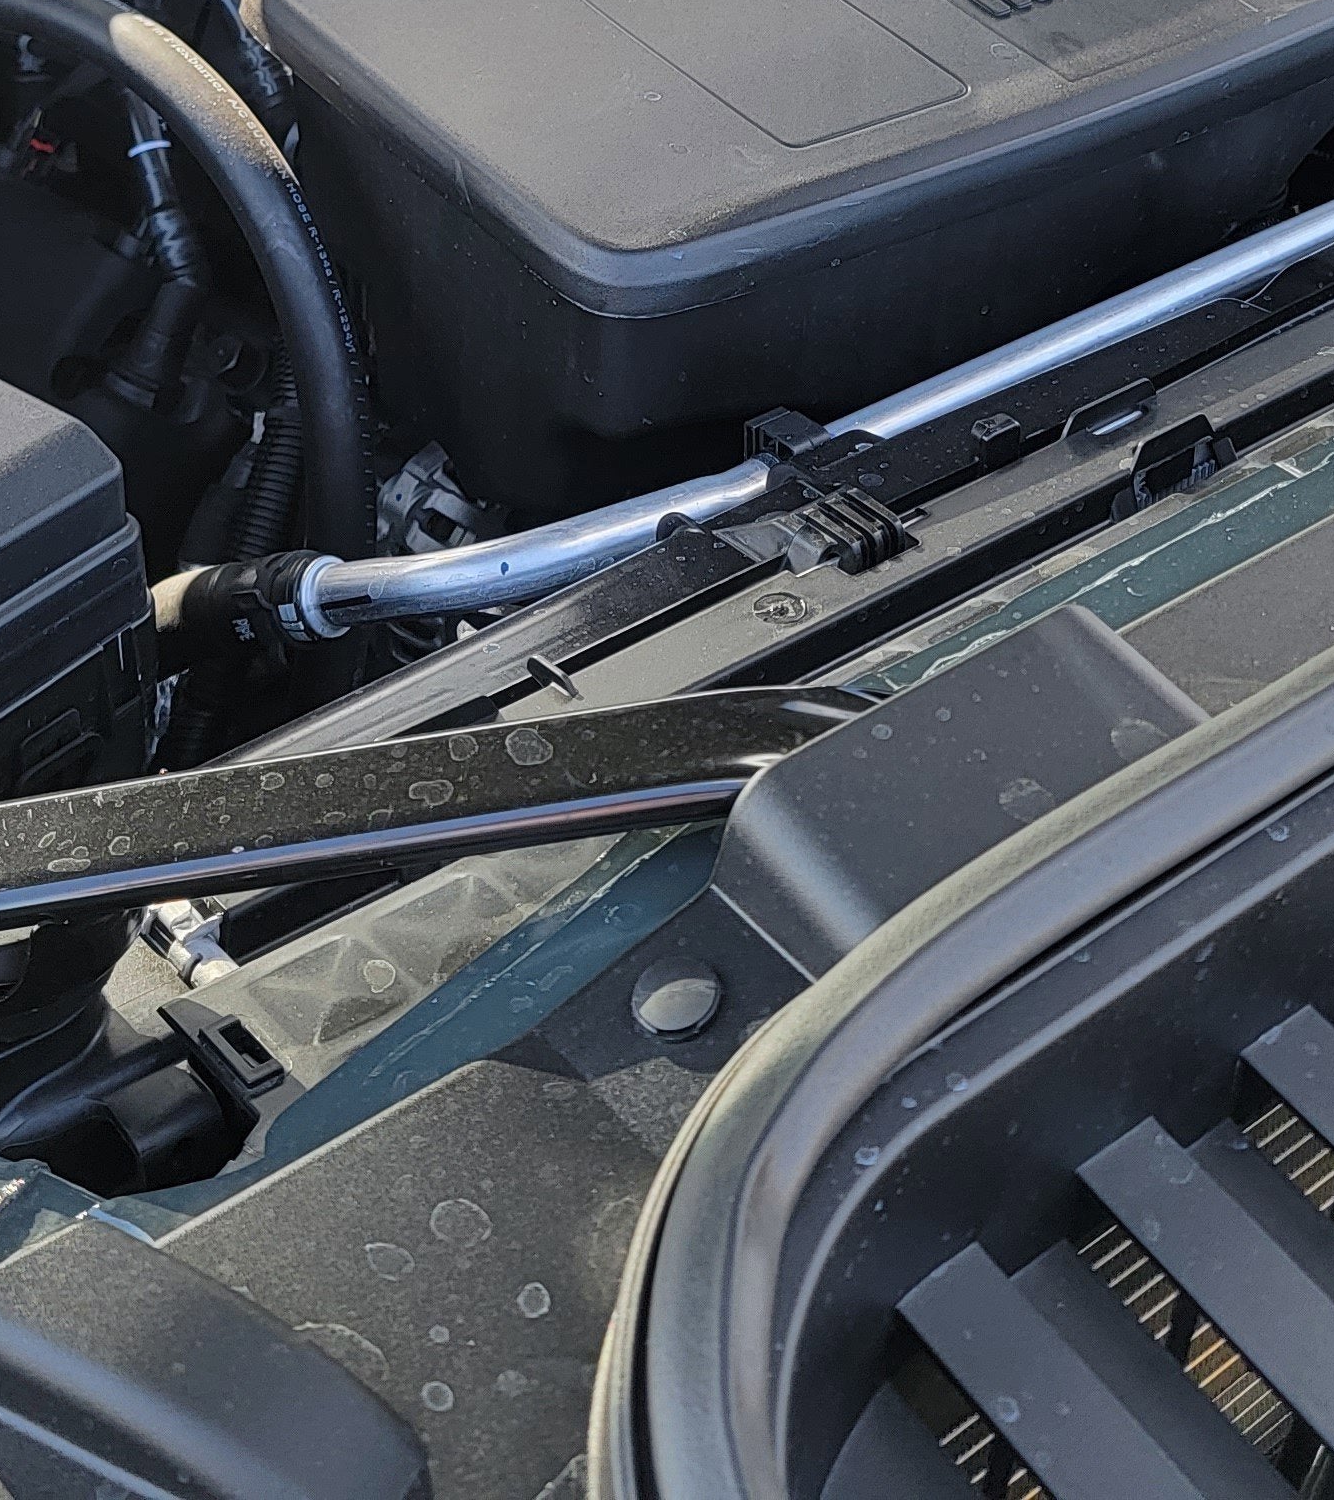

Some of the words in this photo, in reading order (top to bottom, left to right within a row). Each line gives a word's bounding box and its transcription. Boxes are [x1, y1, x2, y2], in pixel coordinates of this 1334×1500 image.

[226, 98, 249, 119] A/C
[245, 121, 289, 179] SUCTION
[285, 182, 312, 223] HOSE
[307, 226, 332, 276] R-134a
